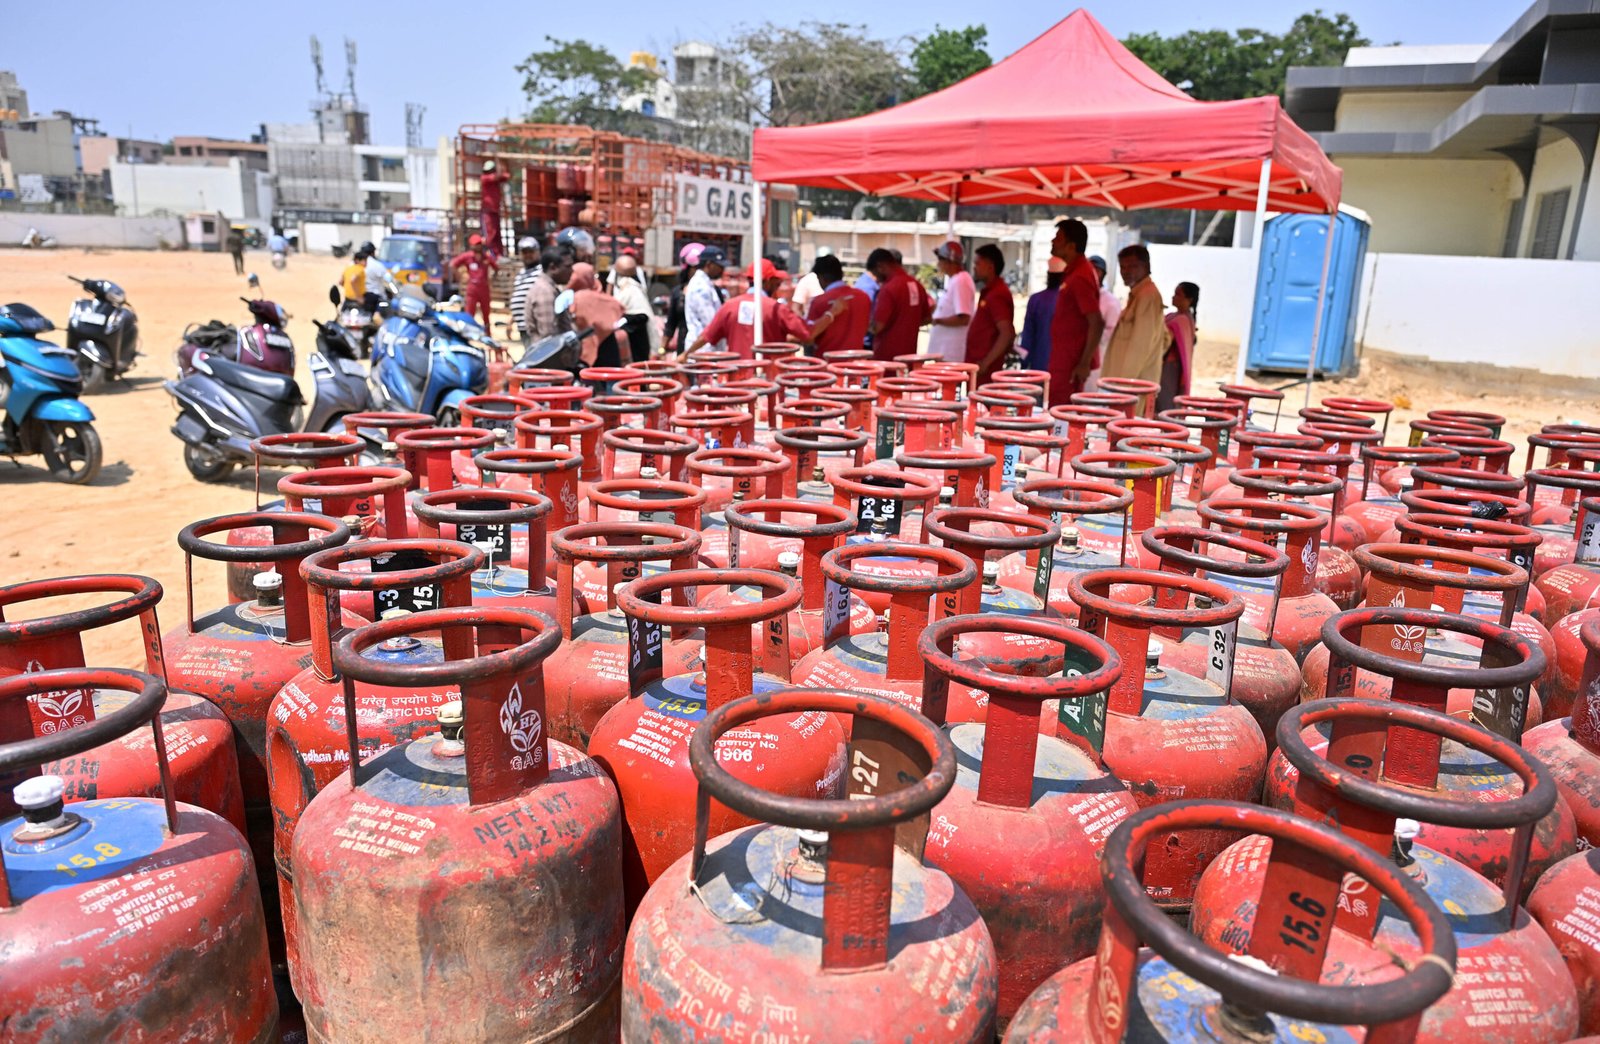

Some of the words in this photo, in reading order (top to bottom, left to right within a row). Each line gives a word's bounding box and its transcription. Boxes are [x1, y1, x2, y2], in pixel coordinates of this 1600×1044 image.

[707, 186, 752, 219] GAS
[862, 497, 876, 520] D-3
[881, 498, 895, 521] 16.
[412, 584, 433, 610] 15.
[837, 583, 849, 620] 16.0
[147, 623, 161, 664] 16.2
[646, 620, 661, 657] 15.
[1214, 629, 1227, 654] 32
[1391, 637, 1424, 654] GAS
[1212, 657, 1223, 671] C
[391, 693, 428, 706] उपयोग
[431, 692, 443, 703] के
[446, 691, 462, 702] लि
[657, 697, 701, 715] 15.9
[1509, 686, 1524, 728] 15.6
[520, 714, 538, 731] HP
[714, 740, 756, 750] rgency
[760, 740, 779, 750] No.
[511, 746, 543, 771] GAS
[658, 755, 676, 768] USE
[849, 749, 880, 801] -27
[351, 842, 399, 859] DELIVER
[385, 838, 421, 855] WEIGHT
[503, 825, 552, 859] 14.2
[55, 842, 122, 878] 15.8
[156, 882, 176, 896] OFF
[143, 909, 166, 926] NOT
[167, 902, 180, 915] IN
[1337, 892, 1369, 918] AS
[1279, 891, 1327, 955] 15.6
[704, 1008, 747, 1044] UE
